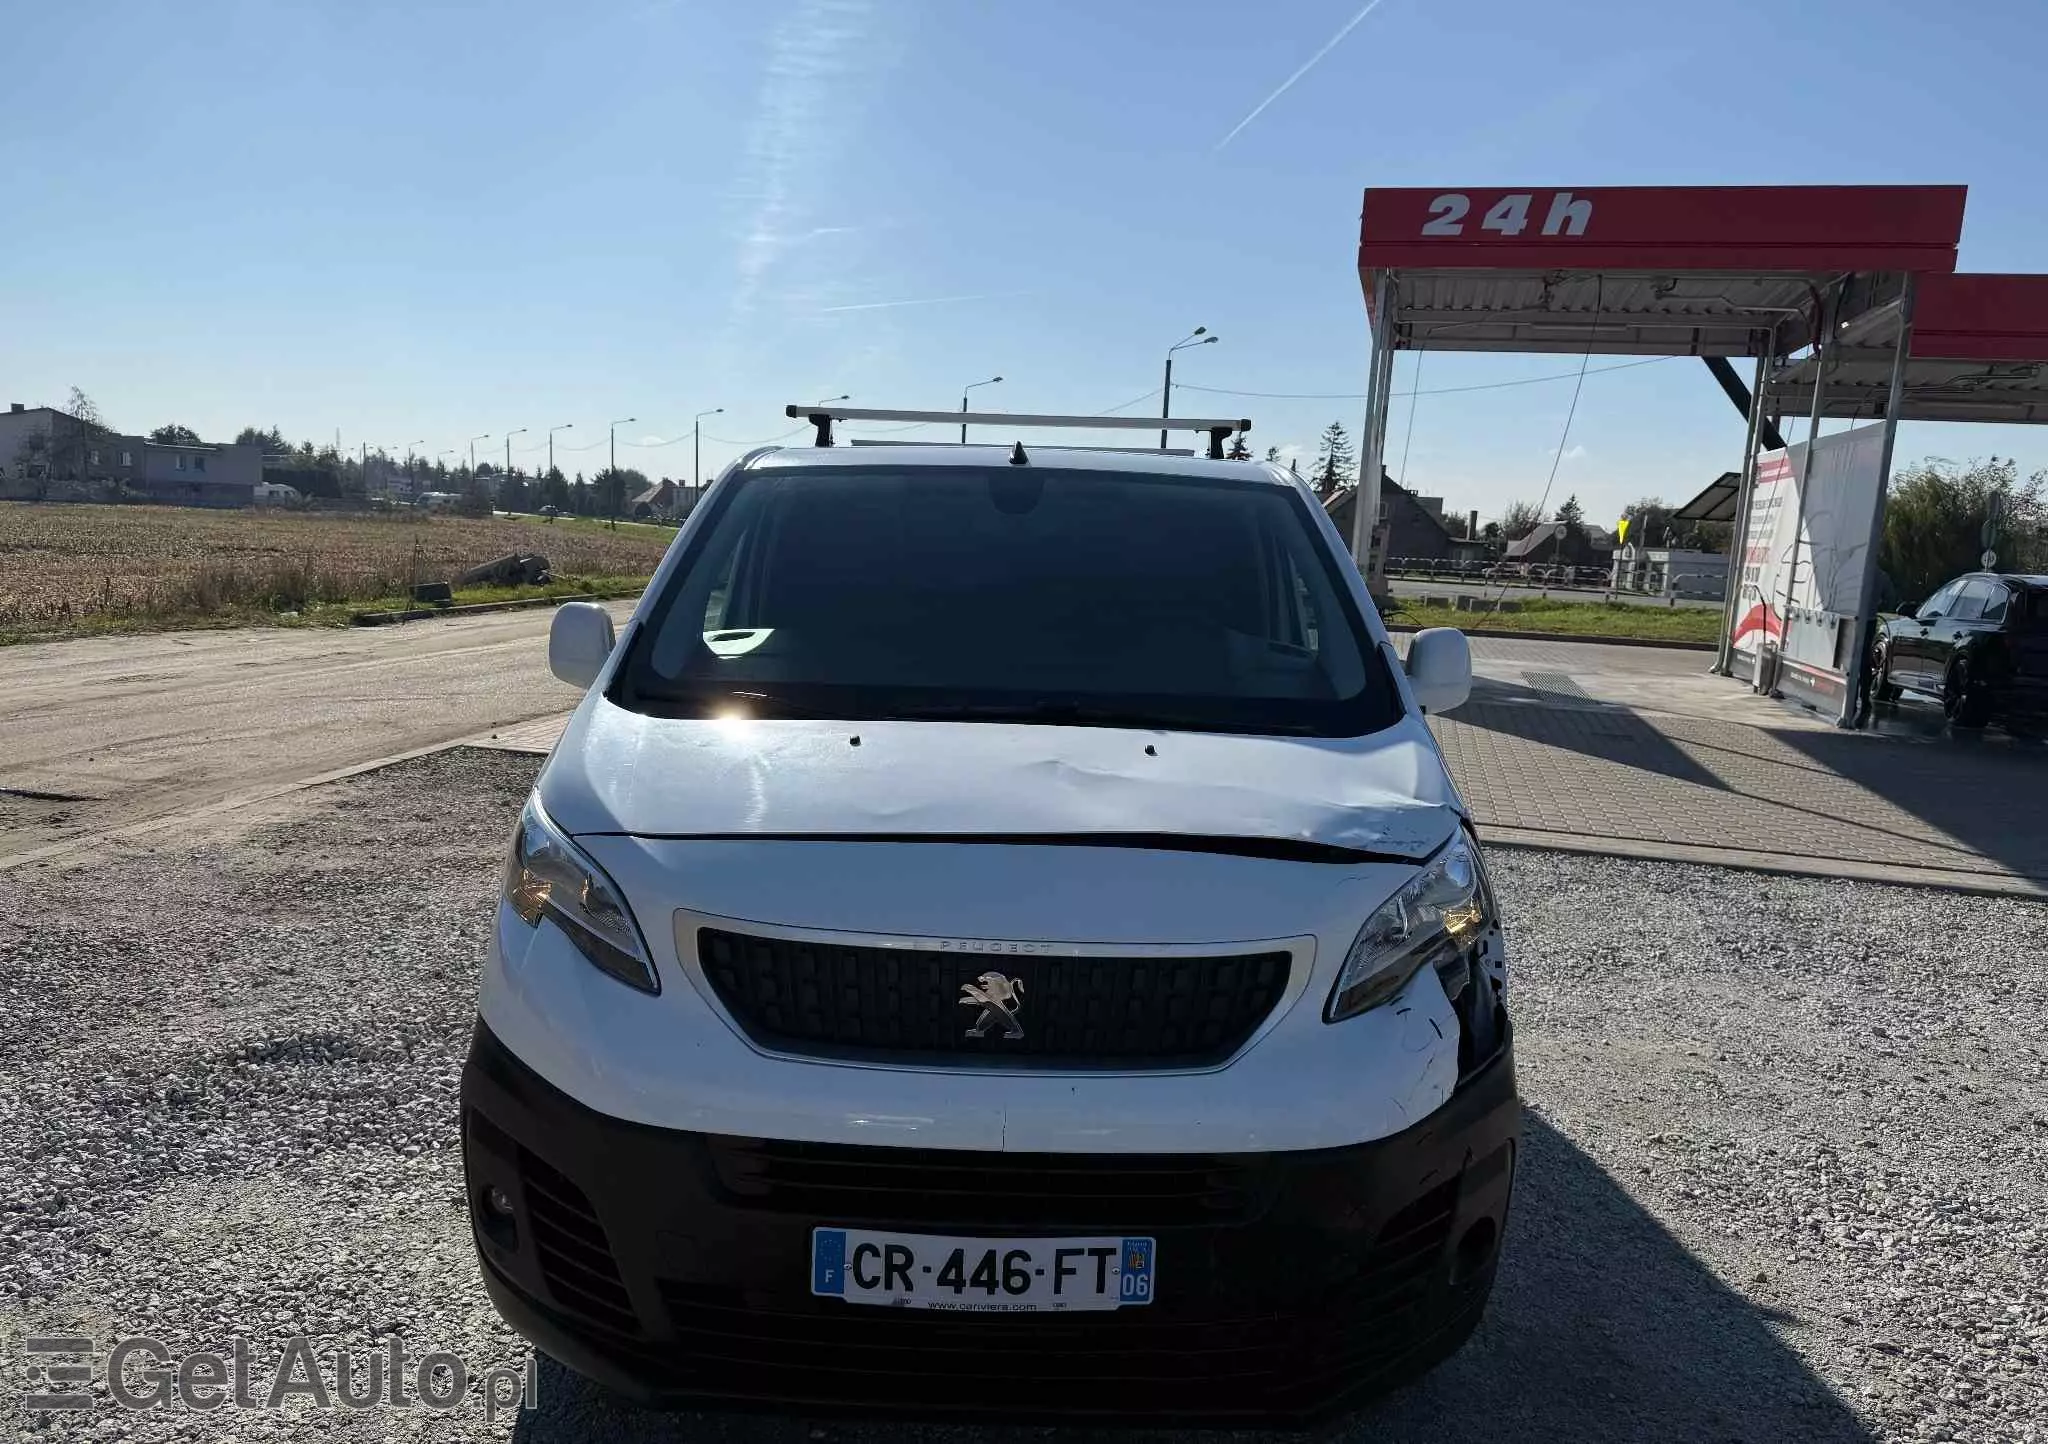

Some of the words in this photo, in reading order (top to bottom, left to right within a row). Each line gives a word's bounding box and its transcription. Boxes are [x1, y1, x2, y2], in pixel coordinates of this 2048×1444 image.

[941, 941, 1053, 953] PEUGEOT
[824, 1268, 836, 1284] F
[852, 1243, 1117, 1295] CR-446-FT
[1121, 1272, 1150, 1297] 06
